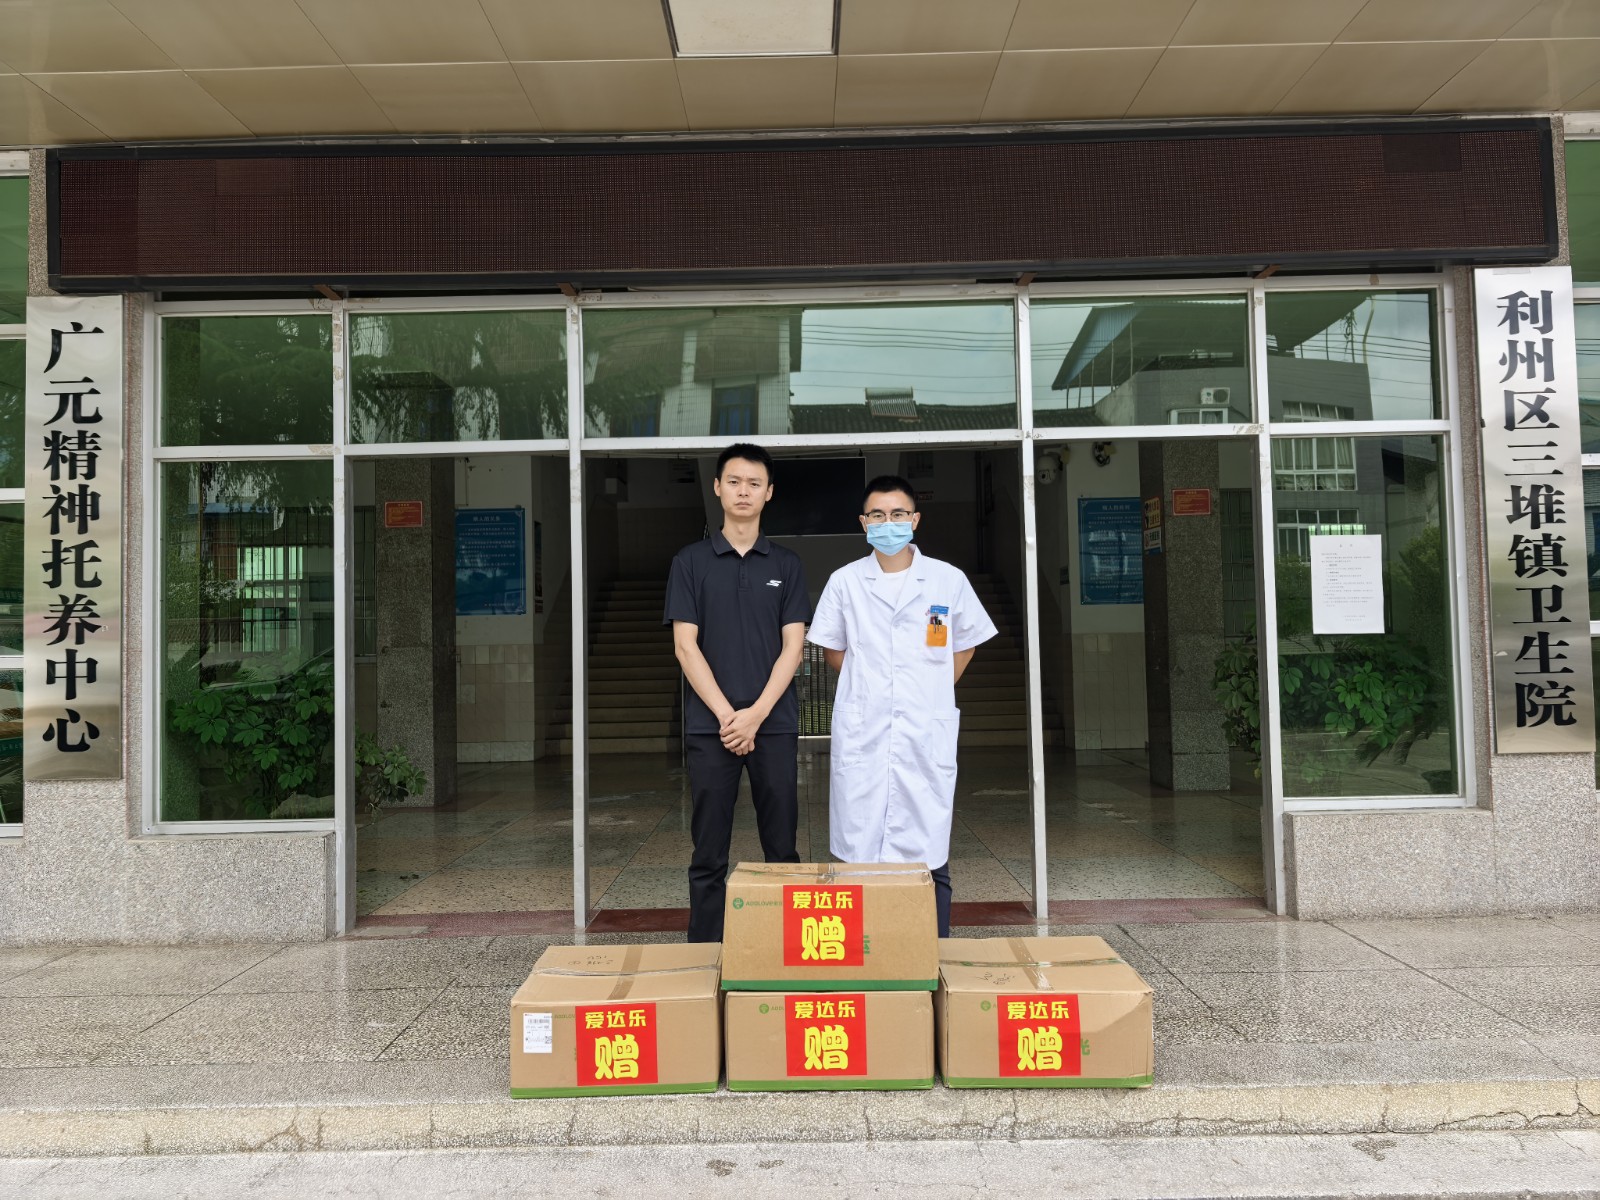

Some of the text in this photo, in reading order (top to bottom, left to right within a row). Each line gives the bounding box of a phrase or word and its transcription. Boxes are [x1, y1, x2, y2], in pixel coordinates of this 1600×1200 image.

[1496, 289, 1578, 728] 利州区三堆镇卫生院
[43, 321, 104, 753] 广元精神托养中心
[792, 891, 853, 909] 爱达乐
[801, 915, 846, 960] 赠
[585, 1009, 647, 1029] 爱达乐
[795, 1000, 856, 1018] 爱达乐
[1007, 1001, 1069, 1019] 爱达乐
[594, 1033, 640, 1080] 赠
[804, 1024, 849, 1070] 赠
[1017, 1026, 1063, 1071] 赠
